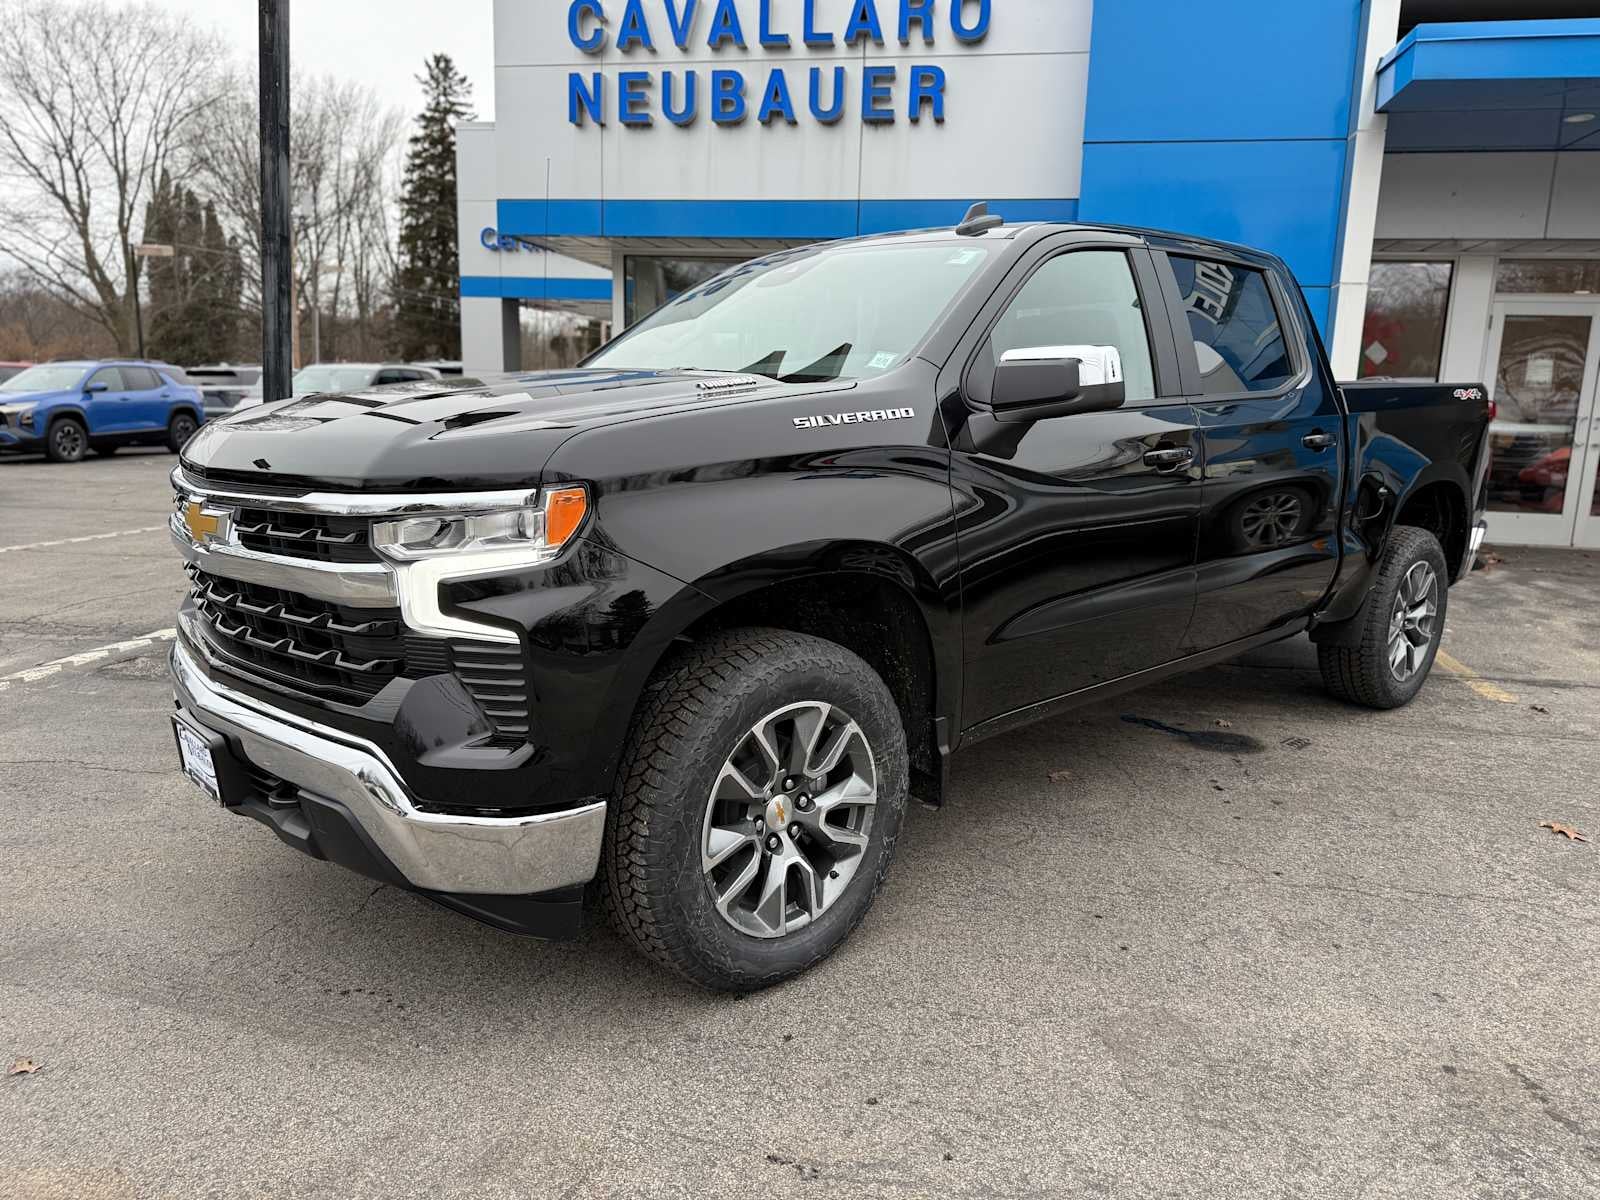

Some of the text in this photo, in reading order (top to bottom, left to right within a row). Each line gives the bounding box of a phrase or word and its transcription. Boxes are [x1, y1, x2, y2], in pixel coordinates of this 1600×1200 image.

[568, 0, 992, 53] CAVALLARO
[568, 65, 946, 127] NEUBAUER
[793, 407, 915, 429] SILVERADO
